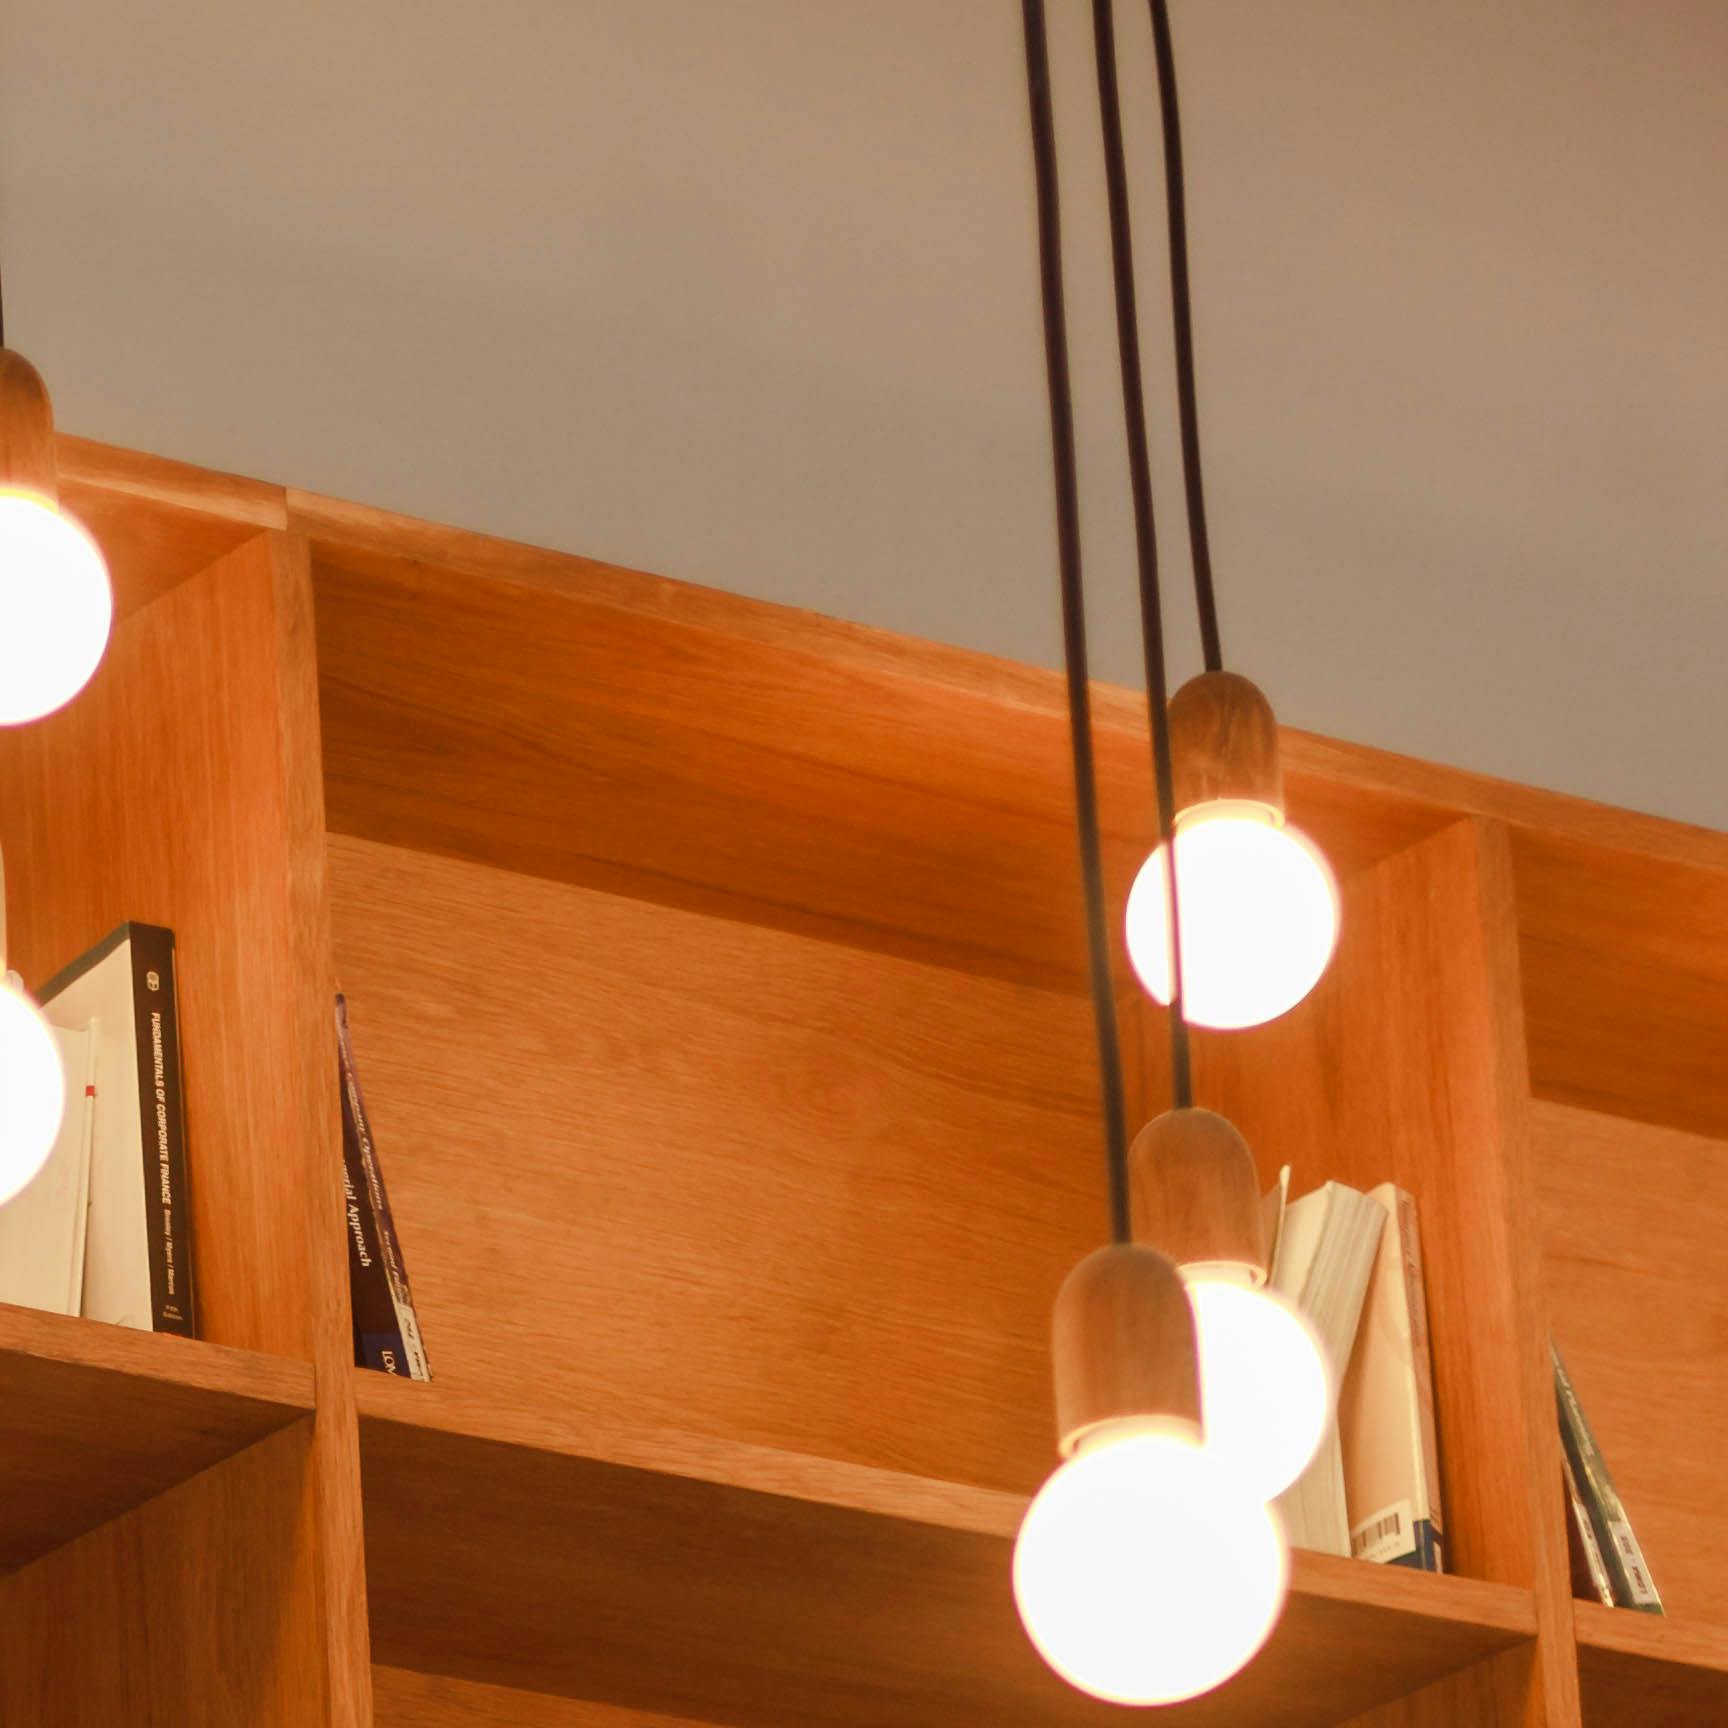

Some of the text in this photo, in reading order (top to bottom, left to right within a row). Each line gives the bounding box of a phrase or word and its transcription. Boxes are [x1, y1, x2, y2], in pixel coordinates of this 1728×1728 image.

[151, 1012, 172, 1206] FUNDAMENTALS OF CORPORATE FINANCE
[346, 1204, 372, 1270] Approach
